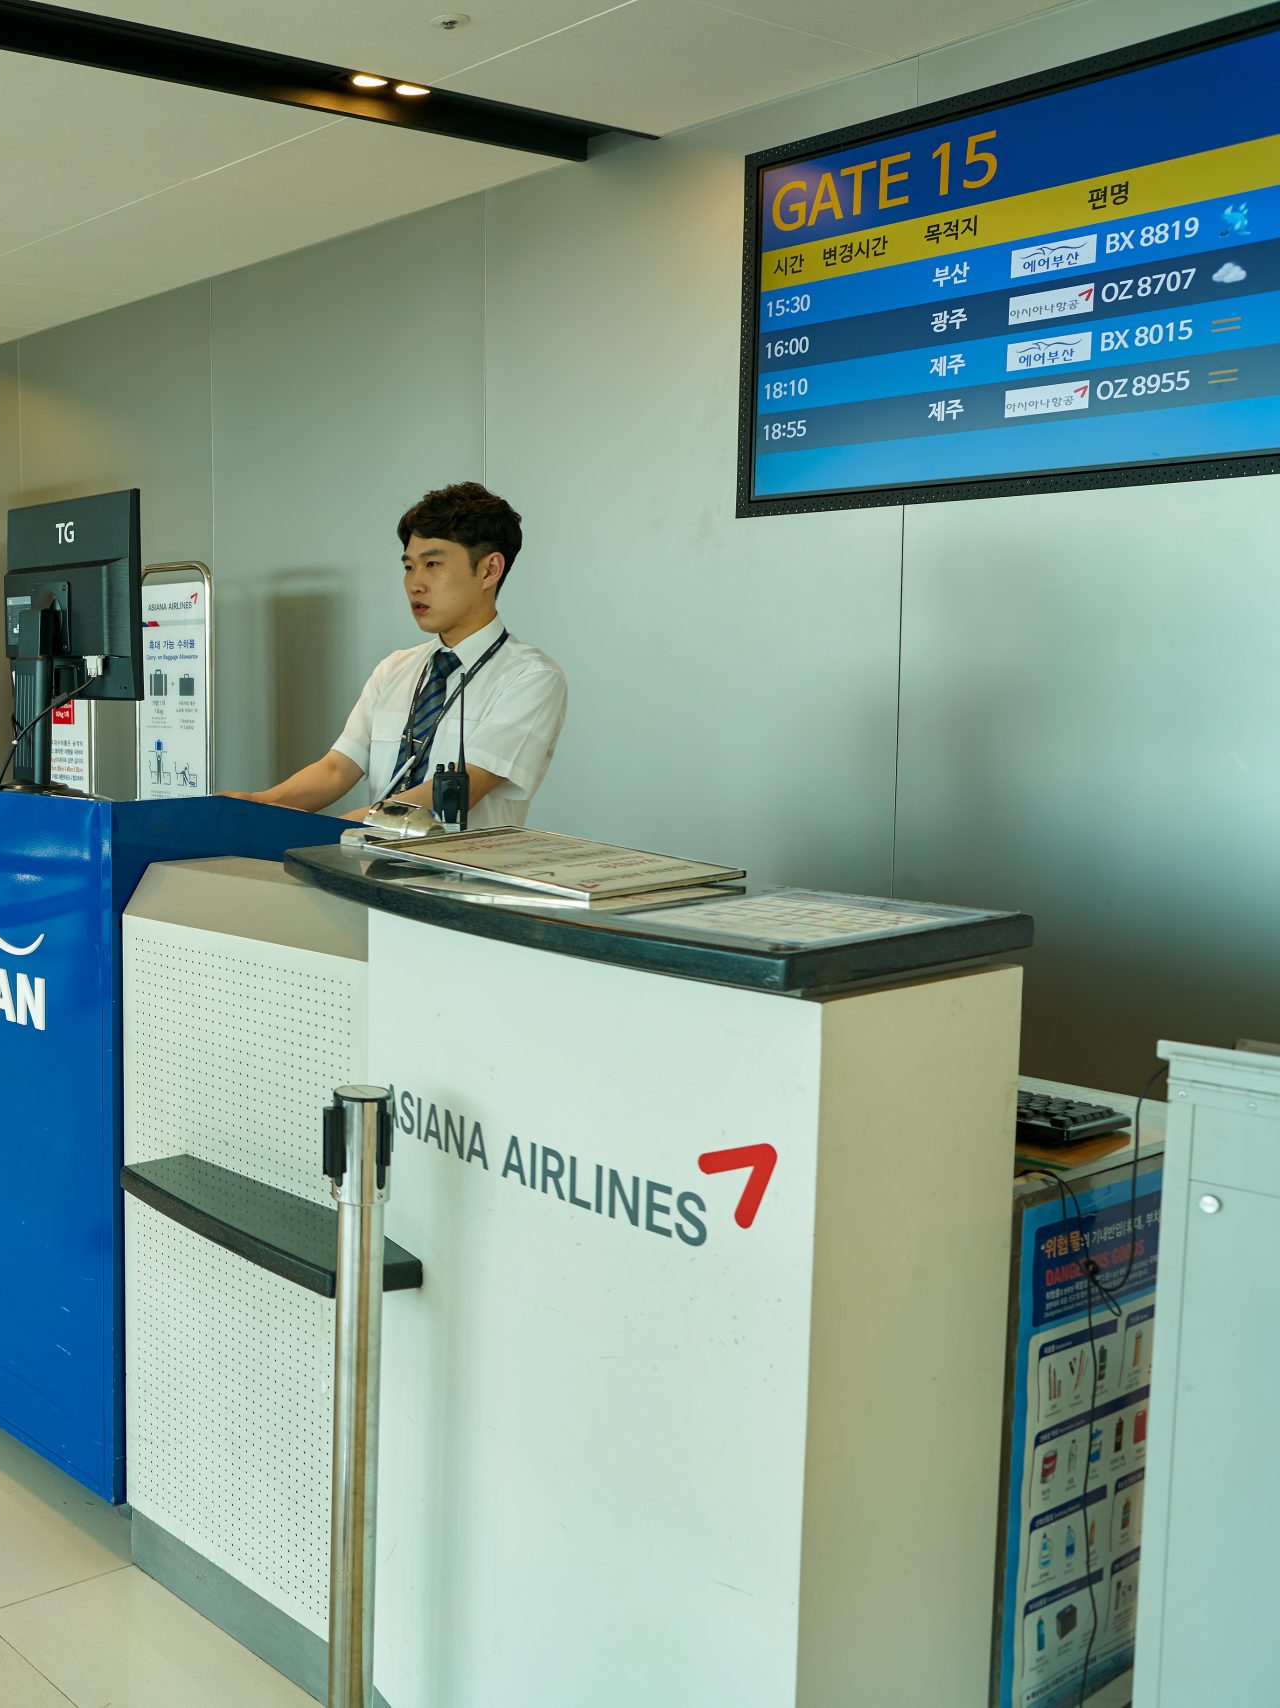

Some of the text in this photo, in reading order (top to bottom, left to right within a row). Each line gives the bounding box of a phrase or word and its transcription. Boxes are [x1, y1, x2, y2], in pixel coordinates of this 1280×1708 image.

[772, 129, 999, 232] GATE 15
[766, 216, 1200, 318] 15:30 부산 에어부산 BX 8819
[773, 181, 1130, 276] 시간 변경시간 목적지 편명
[765, 267, 1197, 359] 16:00 광주 아시아나항공 OZ 8707
[764, 319, 1194, 400] 18:10 제주 에어부산 BX 8015
[763, 370, 1191, 441] 18:55 제주 아시아나항공 OZ 8955
[55, 521, 75, 545] TG
[148, 601, 193, 611] ASIANA AIRLINES
[149, 638, 196, 650] 휴대 가능 수하물
[500, 1134, 708, 1247] AIRLINES
